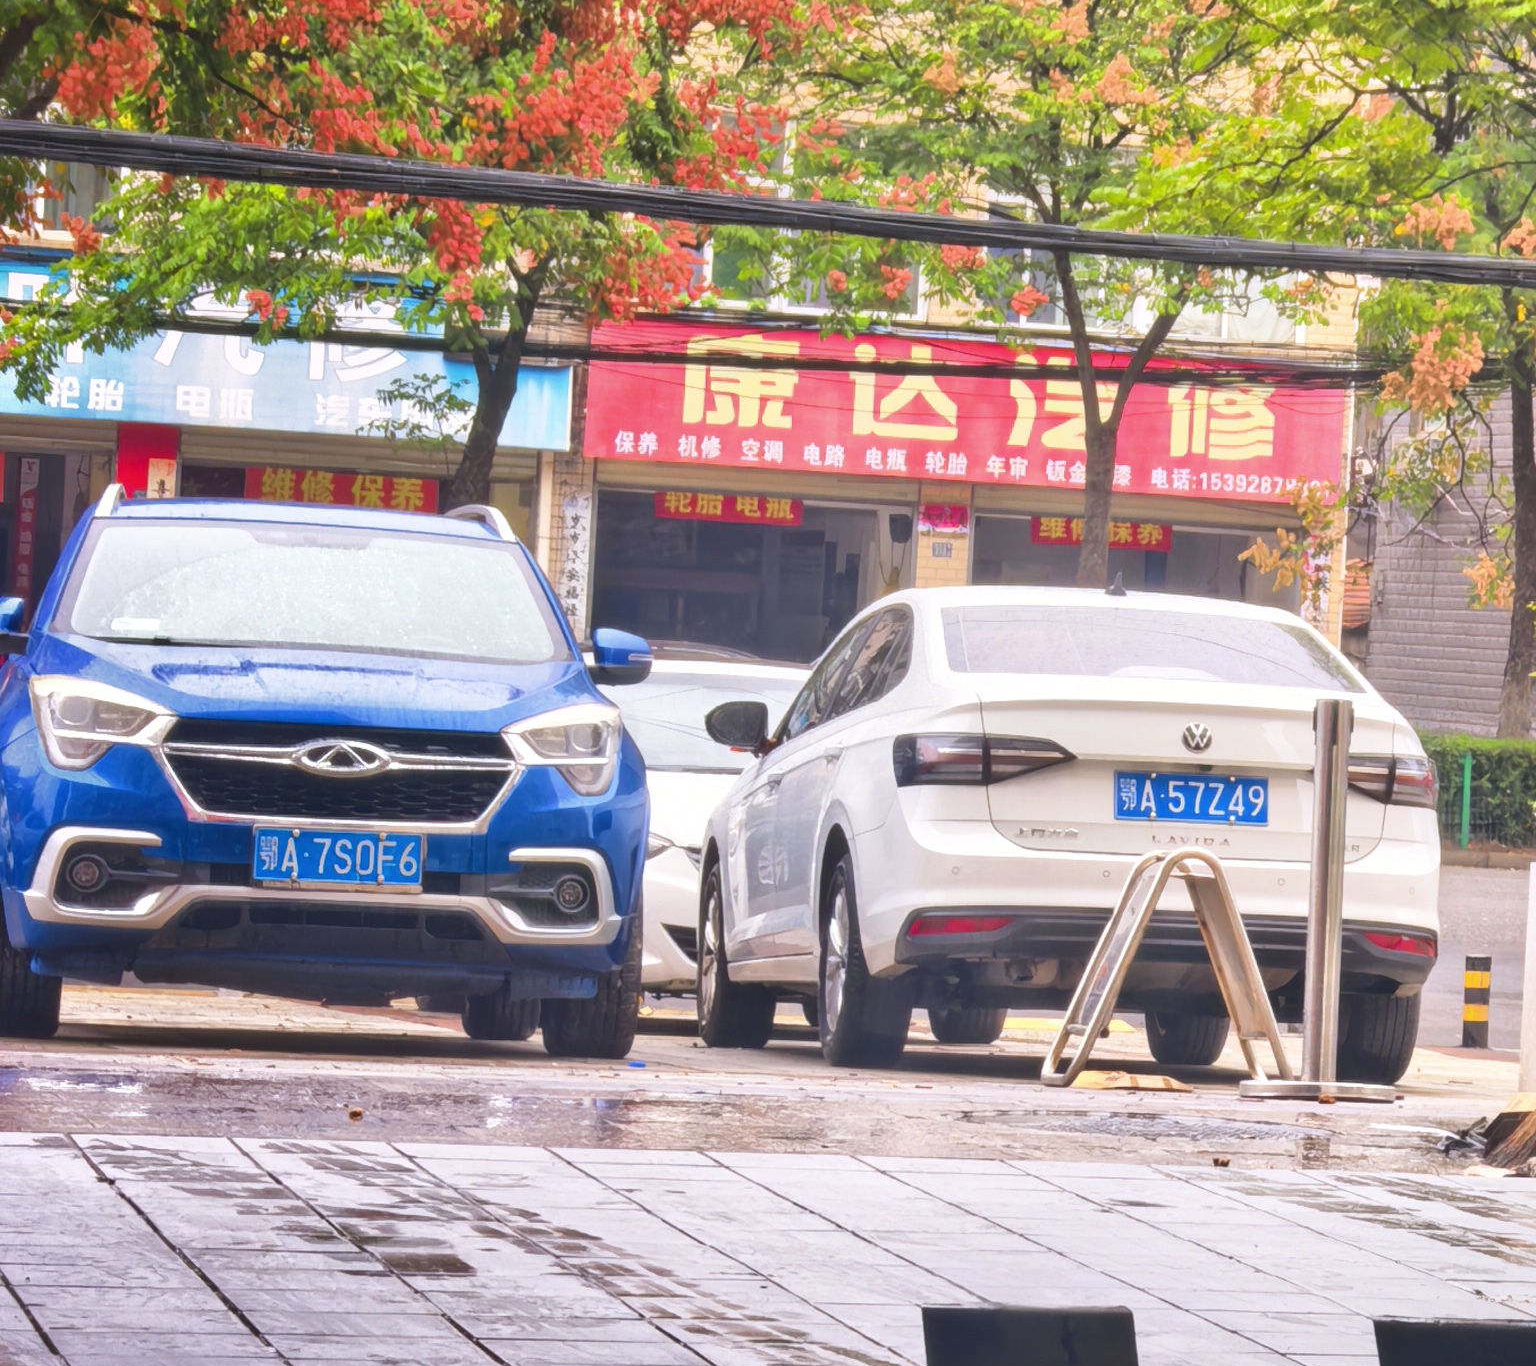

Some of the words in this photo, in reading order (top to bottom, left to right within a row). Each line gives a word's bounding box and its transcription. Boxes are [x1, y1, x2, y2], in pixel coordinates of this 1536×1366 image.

[45, 375, 125, 412] 轮胎
[176, 385, 254, 421] 电瓶
[682, 333, 1277, 461] 康达汽修
[615, 430, 659, 456] 保养
[677, 434, 723, 459] 机修
[740, 438, 784, 464] 空调
[803, 442, 846, 468] 电路
[865, 447, 908, 472] 电瓶
[925, 451, 968, 476] 轮胎
[986, 455, 1029, 480] 年审
[1046, 458, 1132, 488] 钣金漆
[261, 466, 335, 503] 维修
[351, 474, 424, 512] 保养
[664, 492, 724, 515] 轮胎
[735, 494, 795, 520] 电瓶
[1151, 834, 1231, 847] LAVIDA
